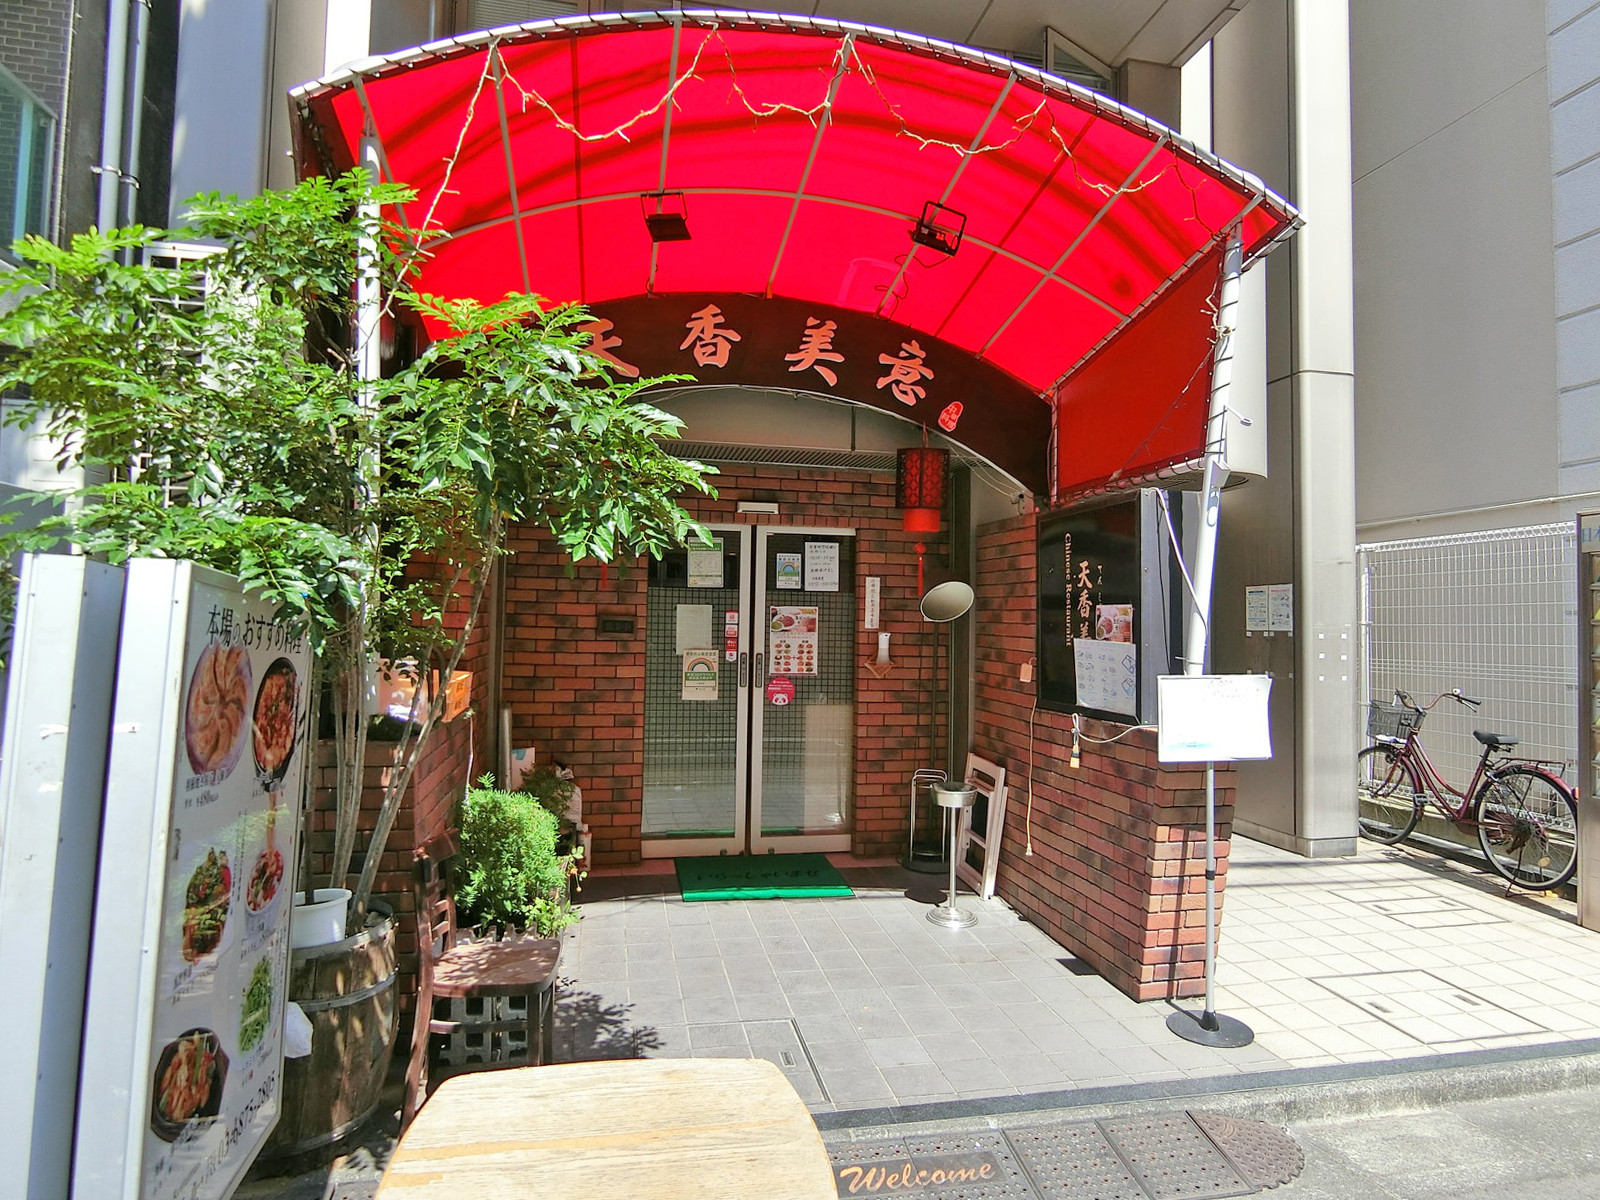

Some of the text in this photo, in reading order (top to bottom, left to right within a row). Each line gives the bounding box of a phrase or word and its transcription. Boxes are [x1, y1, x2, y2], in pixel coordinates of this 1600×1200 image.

[1064, 532, 1073, 647] Chinese Restaurant
[840, 1163, 995, 1194] Welcome
